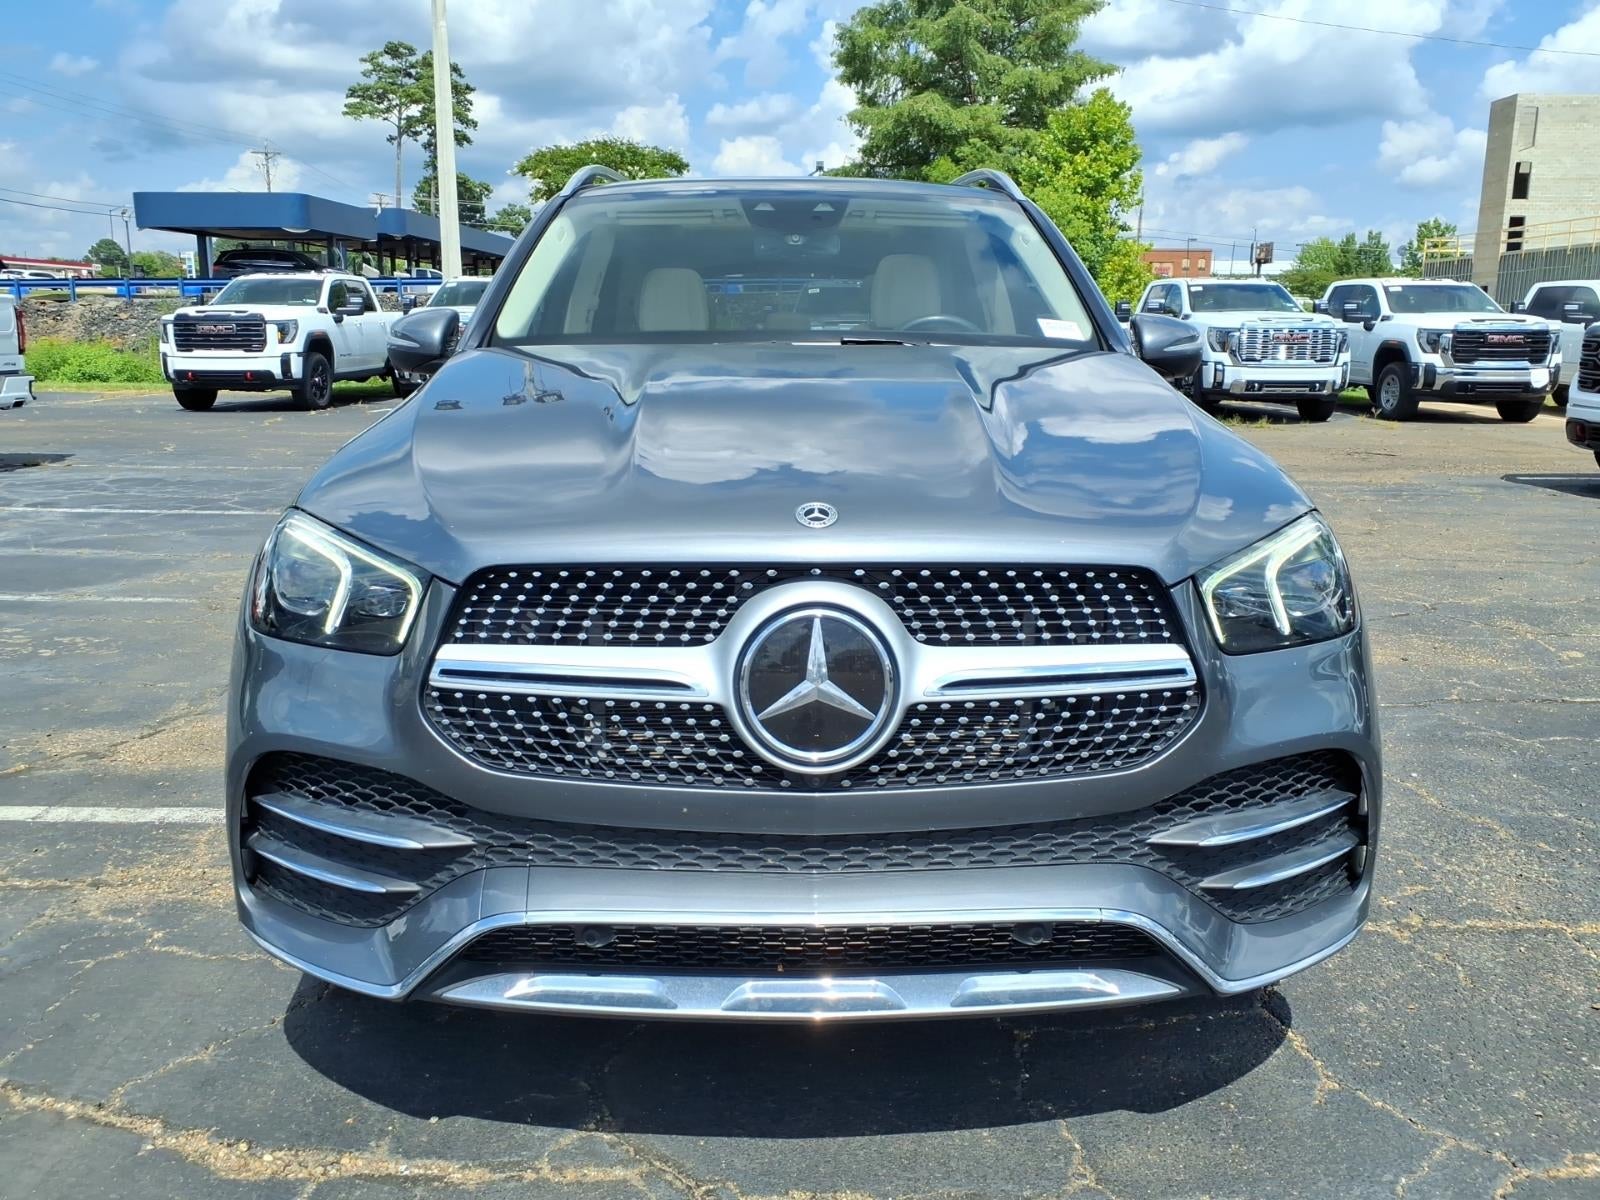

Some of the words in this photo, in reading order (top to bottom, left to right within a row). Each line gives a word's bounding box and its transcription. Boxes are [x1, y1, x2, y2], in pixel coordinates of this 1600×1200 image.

[198, 325, 233, 334] GMC
[1273, 333, 1310, 343] GMC
[1487, 334, 1525, 344] GMC
